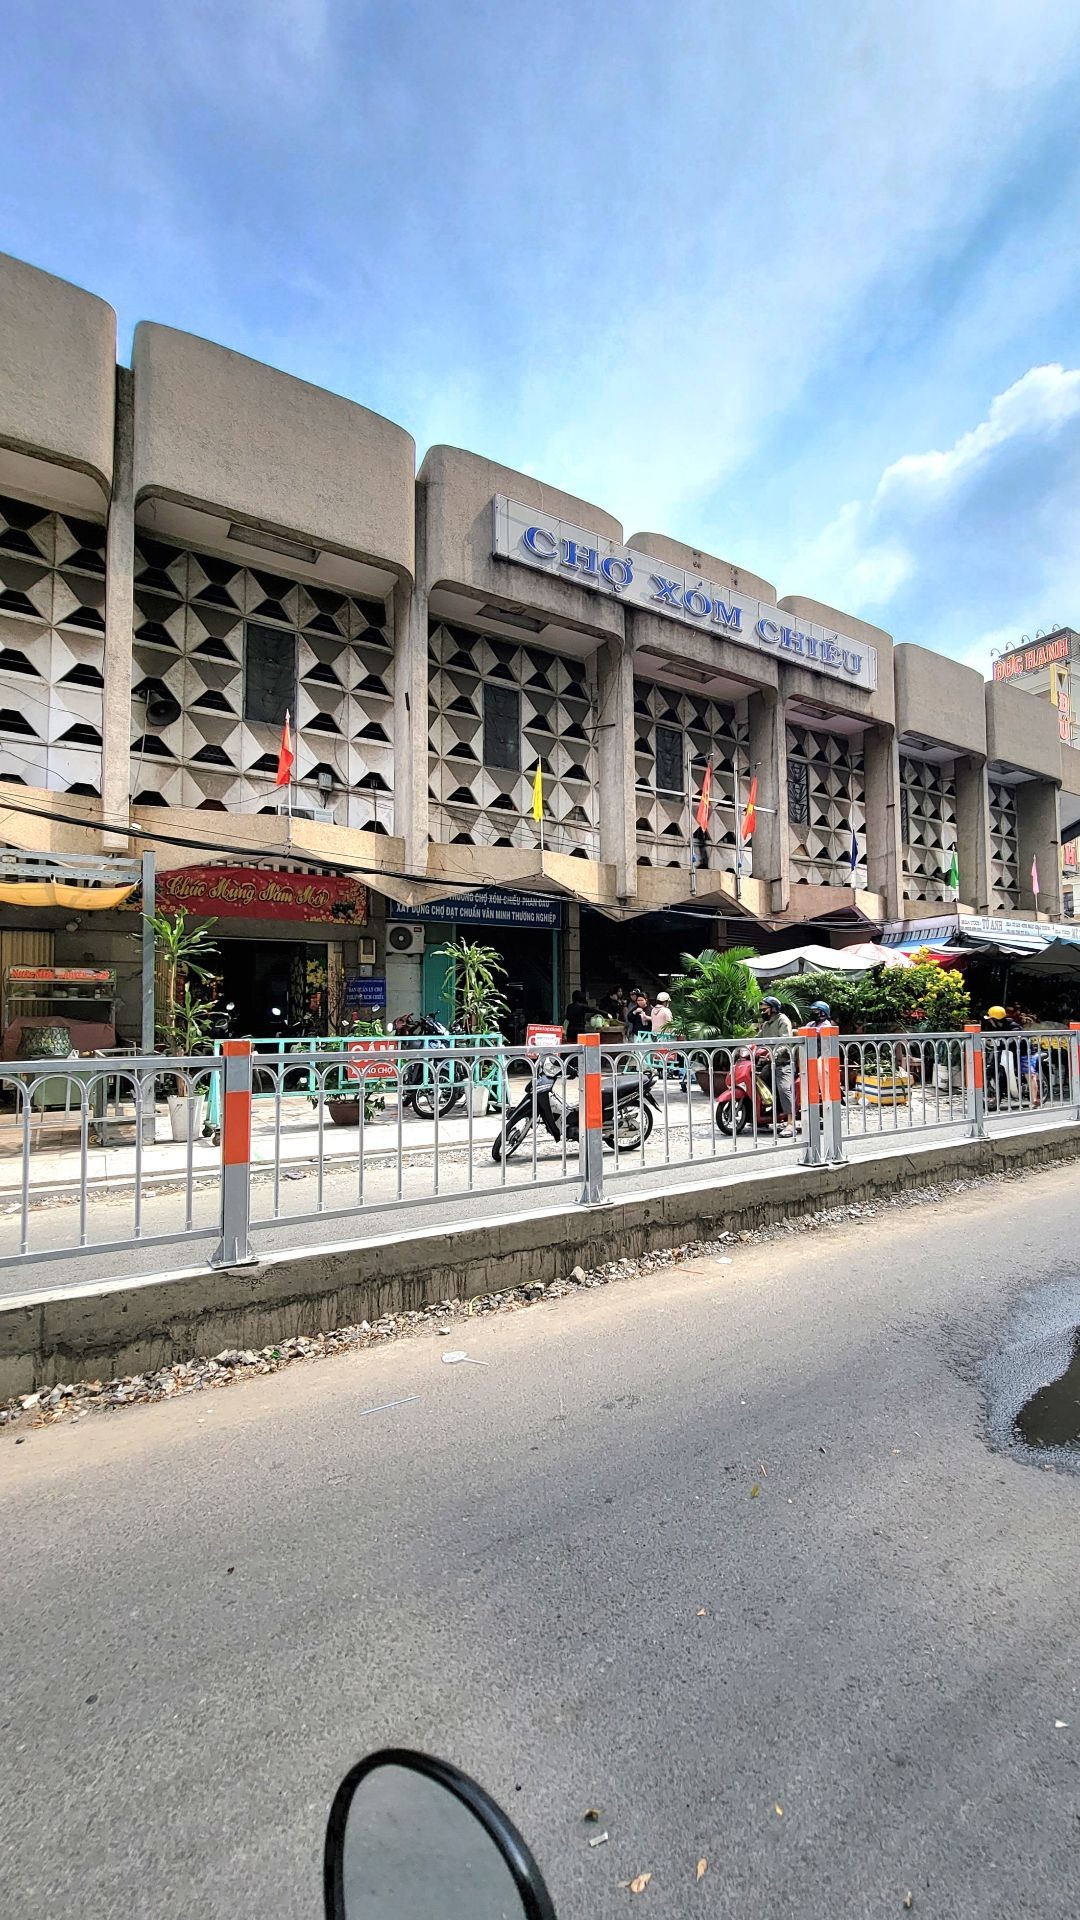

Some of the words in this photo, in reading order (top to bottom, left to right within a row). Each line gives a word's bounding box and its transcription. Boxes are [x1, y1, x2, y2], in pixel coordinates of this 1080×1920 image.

[522, 526, 634, 592] CHỢ
[650, 573, 743, 632] XÓM
[755, 617, 864, 675] CHIẾU
[995, 654, 1024, 680] ĐỨC
[1024, 637, 1069, 670] HẠNH
[166, 875, 208, 899] Chúc
[209, 877, 257, 904] Mừng
[259, 880, 295, 904] Năm
[296, 884, 330, 908] Mới
[474, 892, 488, 905] CHỢ
[488, 891, 502, 904] XÓM
[431, 904, 445, 919] CHỢ
[445, 907, 459, 919] ĐẠT
[459, 904, 481, 919] CHUẨN
[482, 906, 495, 919] VĂN
[495, 909, 511, 920] MINH
[511, 909, 535, 922] THƯƠNG
[535, 911, 557, 925] NGHIỆP
[377, 1067, 393, 1075] CHỢ
